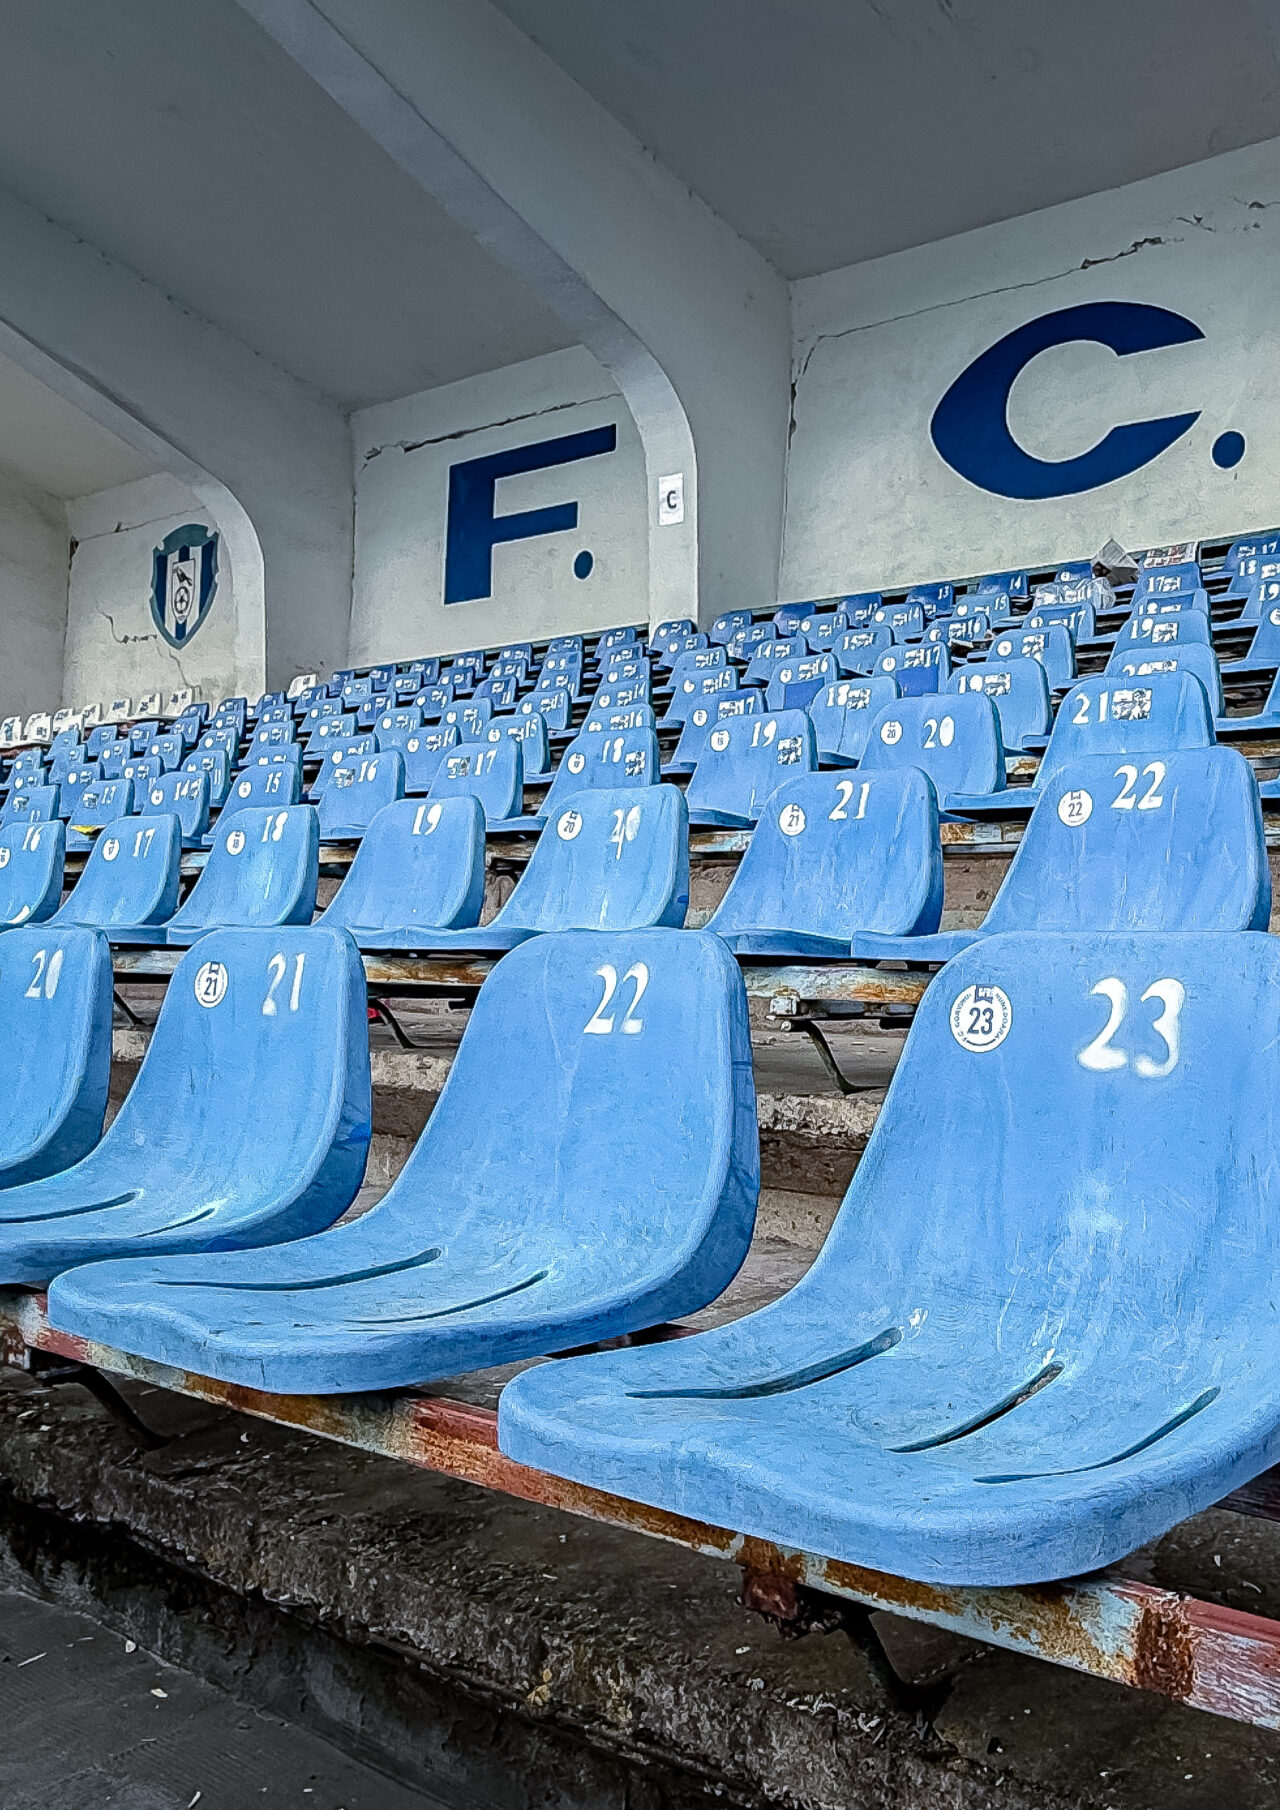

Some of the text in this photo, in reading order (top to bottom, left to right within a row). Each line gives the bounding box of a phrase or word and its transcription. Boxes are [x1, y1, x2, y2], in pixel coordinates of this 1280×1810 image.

[666, 491, 677, 509] C
[1262, 541, 1277, 553] 17
[1239, 560, 1256, 576] 18
[938, 586, 949, 599] 13
[1010, 576, 1021, 590] 14
[1259, 584, 1280, 600] 19
[994, 596, 1006, 610] 15
[909, 607, 919, 622] 14
[1070, 610, 1086, 629] 17
[1130, 619, 1153, 639] 19
[757, 644, 772, 658] 14
[718, 671, 730, 688] 15
[827, 684, 849, 706] 18
[630, 709, 643, 727] 16
[1073, 692, 1108, 724] 21
[525, 719, 538, 738] 15
[751, 721, 776, 747] 19
[924, 716, 954, 749] 20
[602, 737, 625, 763] 18
[358, 759, 379, 782] 16
[475, 749, 496, 776] 17
[265, 772, 282, 793] 15
[1111, 761, 1166, 809] 22
[824, 781, 870, 820] 21
[1068, 802, 1082, 817] 22
[261, 811, 289, 842] 18
[412, 803, 442, 835] 19
[564, 821, 575, 833] 20
[22, 826, 44, 851] 16
[133, 828, 156, 859] 17
[25, 949, 63, 999] 20
[263, 952, 306, 1016] 21
[203, 977, 219, 998] 21
[584, 962, 649, 1036] 22
[967, 1007, 993, 1034] 23
[1078, 977, 1185, 1078] 23
